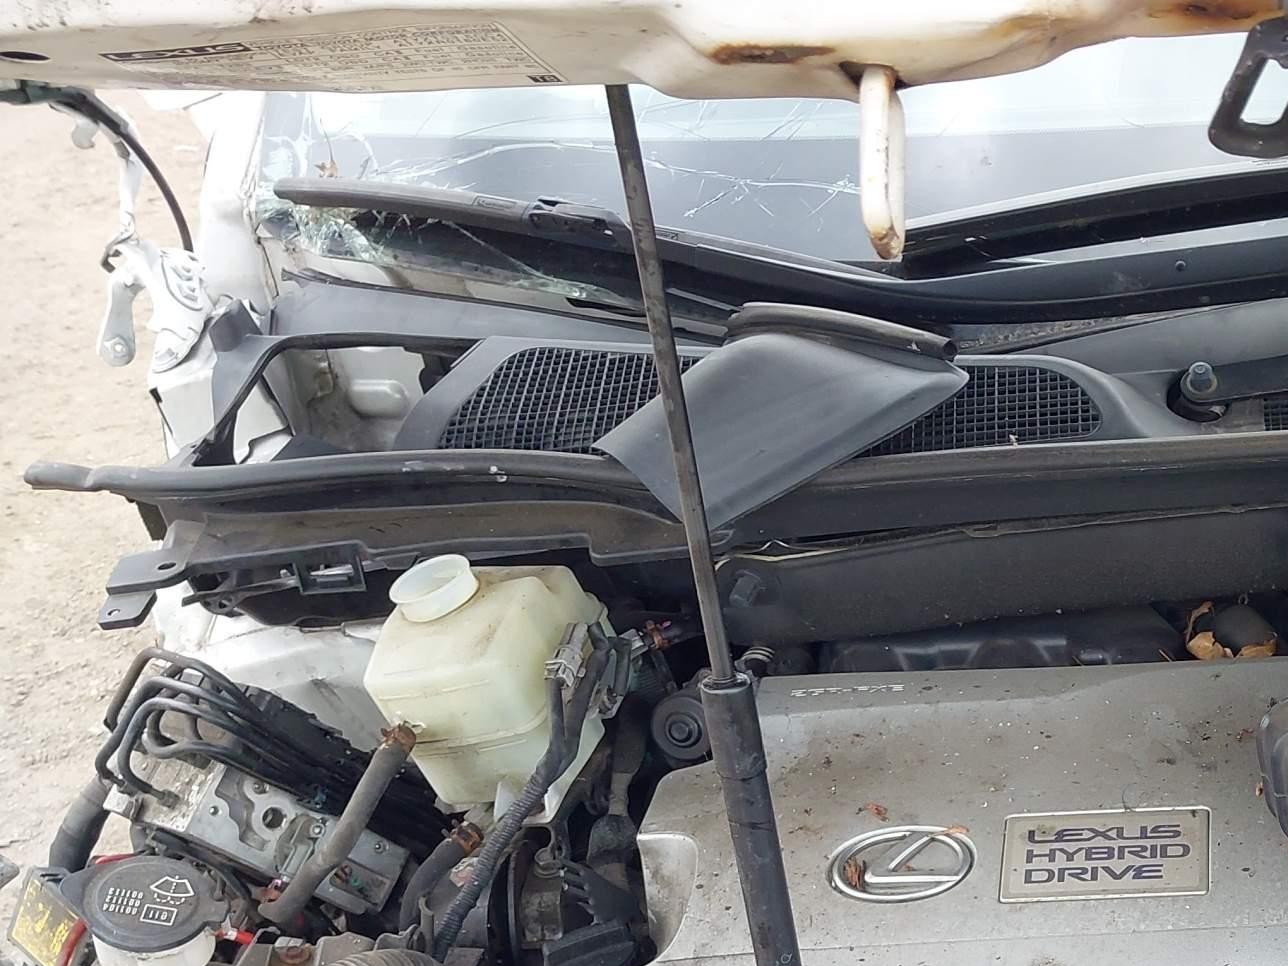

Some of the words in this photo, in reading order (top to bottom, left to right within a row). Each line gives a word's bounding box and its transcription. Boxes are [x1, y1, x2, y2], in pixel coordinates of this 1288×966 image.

[106, 44, 246, 60] LEXUS
[1027, 824, 1182, 845] LEXUS
[1025, 843, 1191, 865] HYBRID
[1023, 863, 1164, 885] DRIVE
